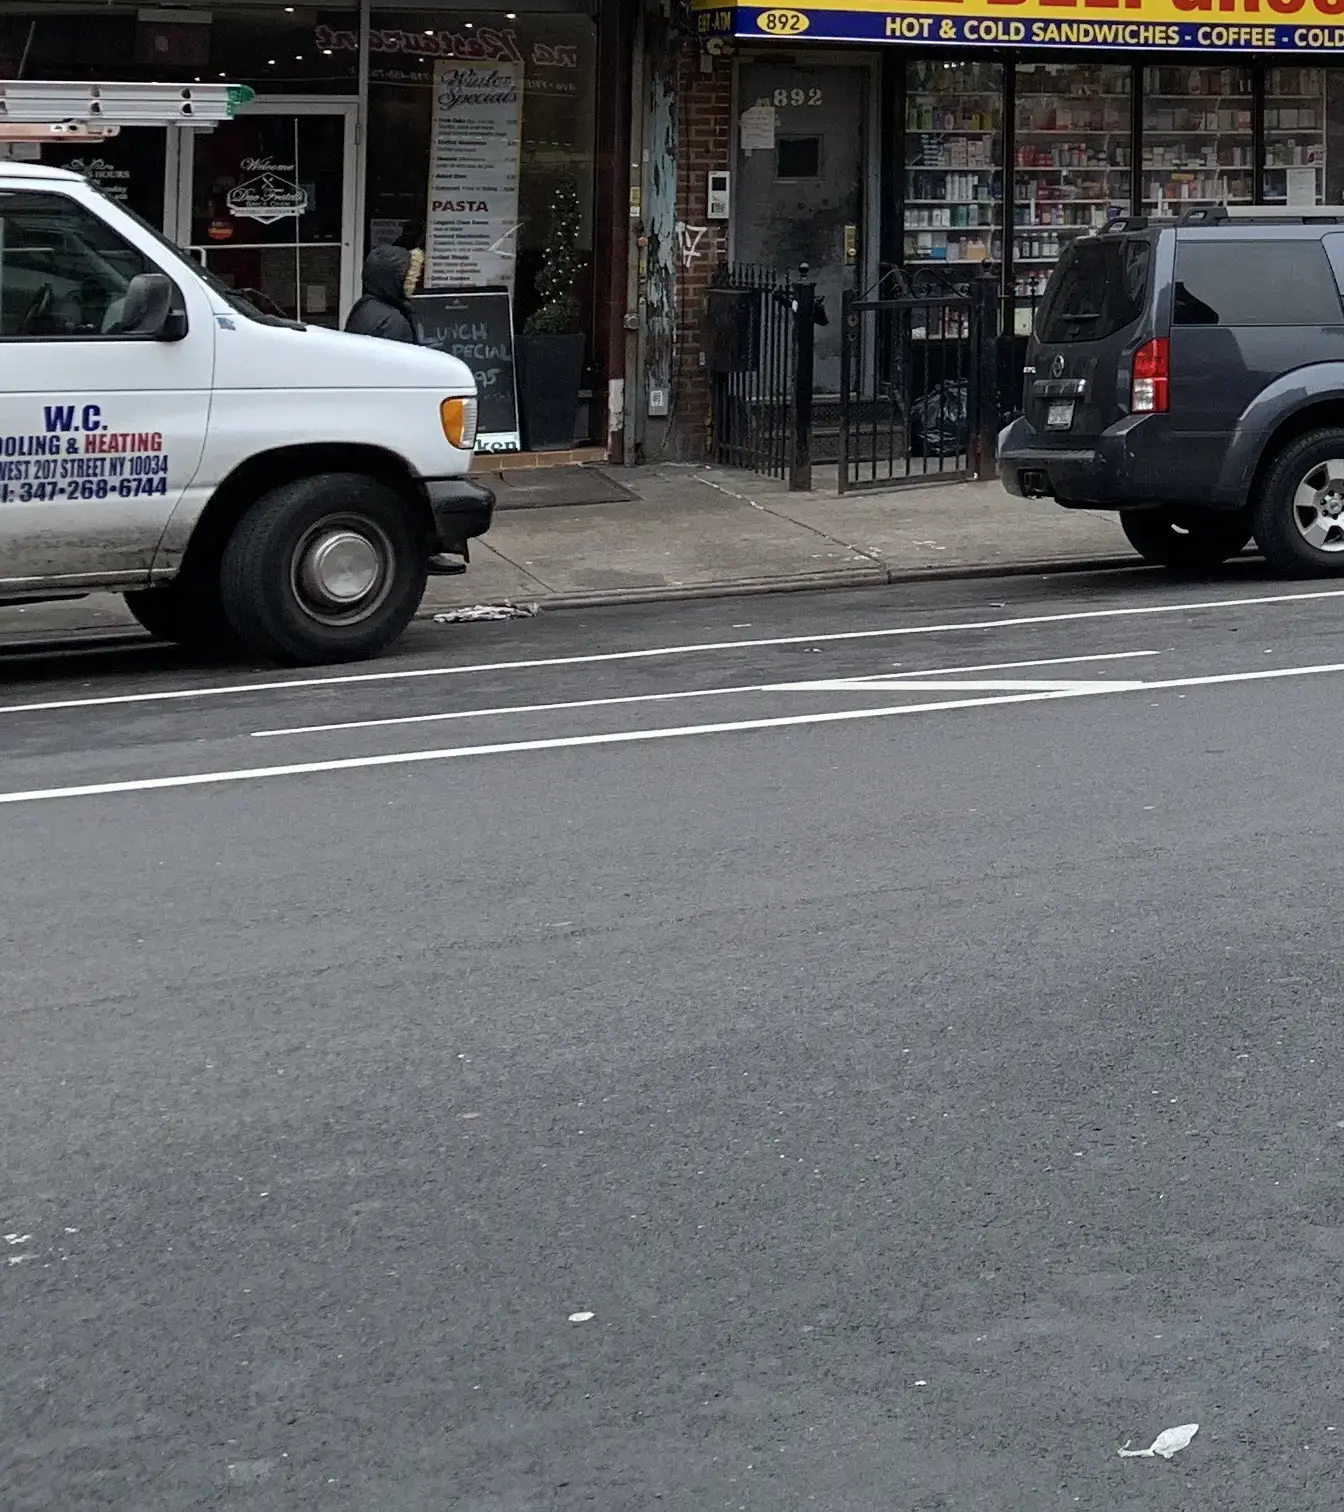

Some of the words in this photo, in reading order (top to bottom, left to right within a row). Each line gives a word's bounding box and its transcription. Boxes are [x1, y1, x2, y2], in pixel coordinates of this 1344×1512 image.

[766, 13, 801, 31] 892
[885, 17, 934, 38] HOT
[939, 20, 956, 39] &
[963, 20, 1026, 41] COLD
[1031, 23, 1180, 45] SANDWICHES
[1197, 26, 1276, 46] COFFEE
[773, 88, 822, 107] 892
[431, 200, 489, 213] PASTA
[44, 404, 109, 433] W.C.
[65, 438, 79, 455] &
[84, 432, 163, 455] HEATING
[33, 458, 57, 480] 207
[60, 457, 106, 479] STREET
[109, 456, 126, 476] NY
[128, 454, 169, 476] 10034
